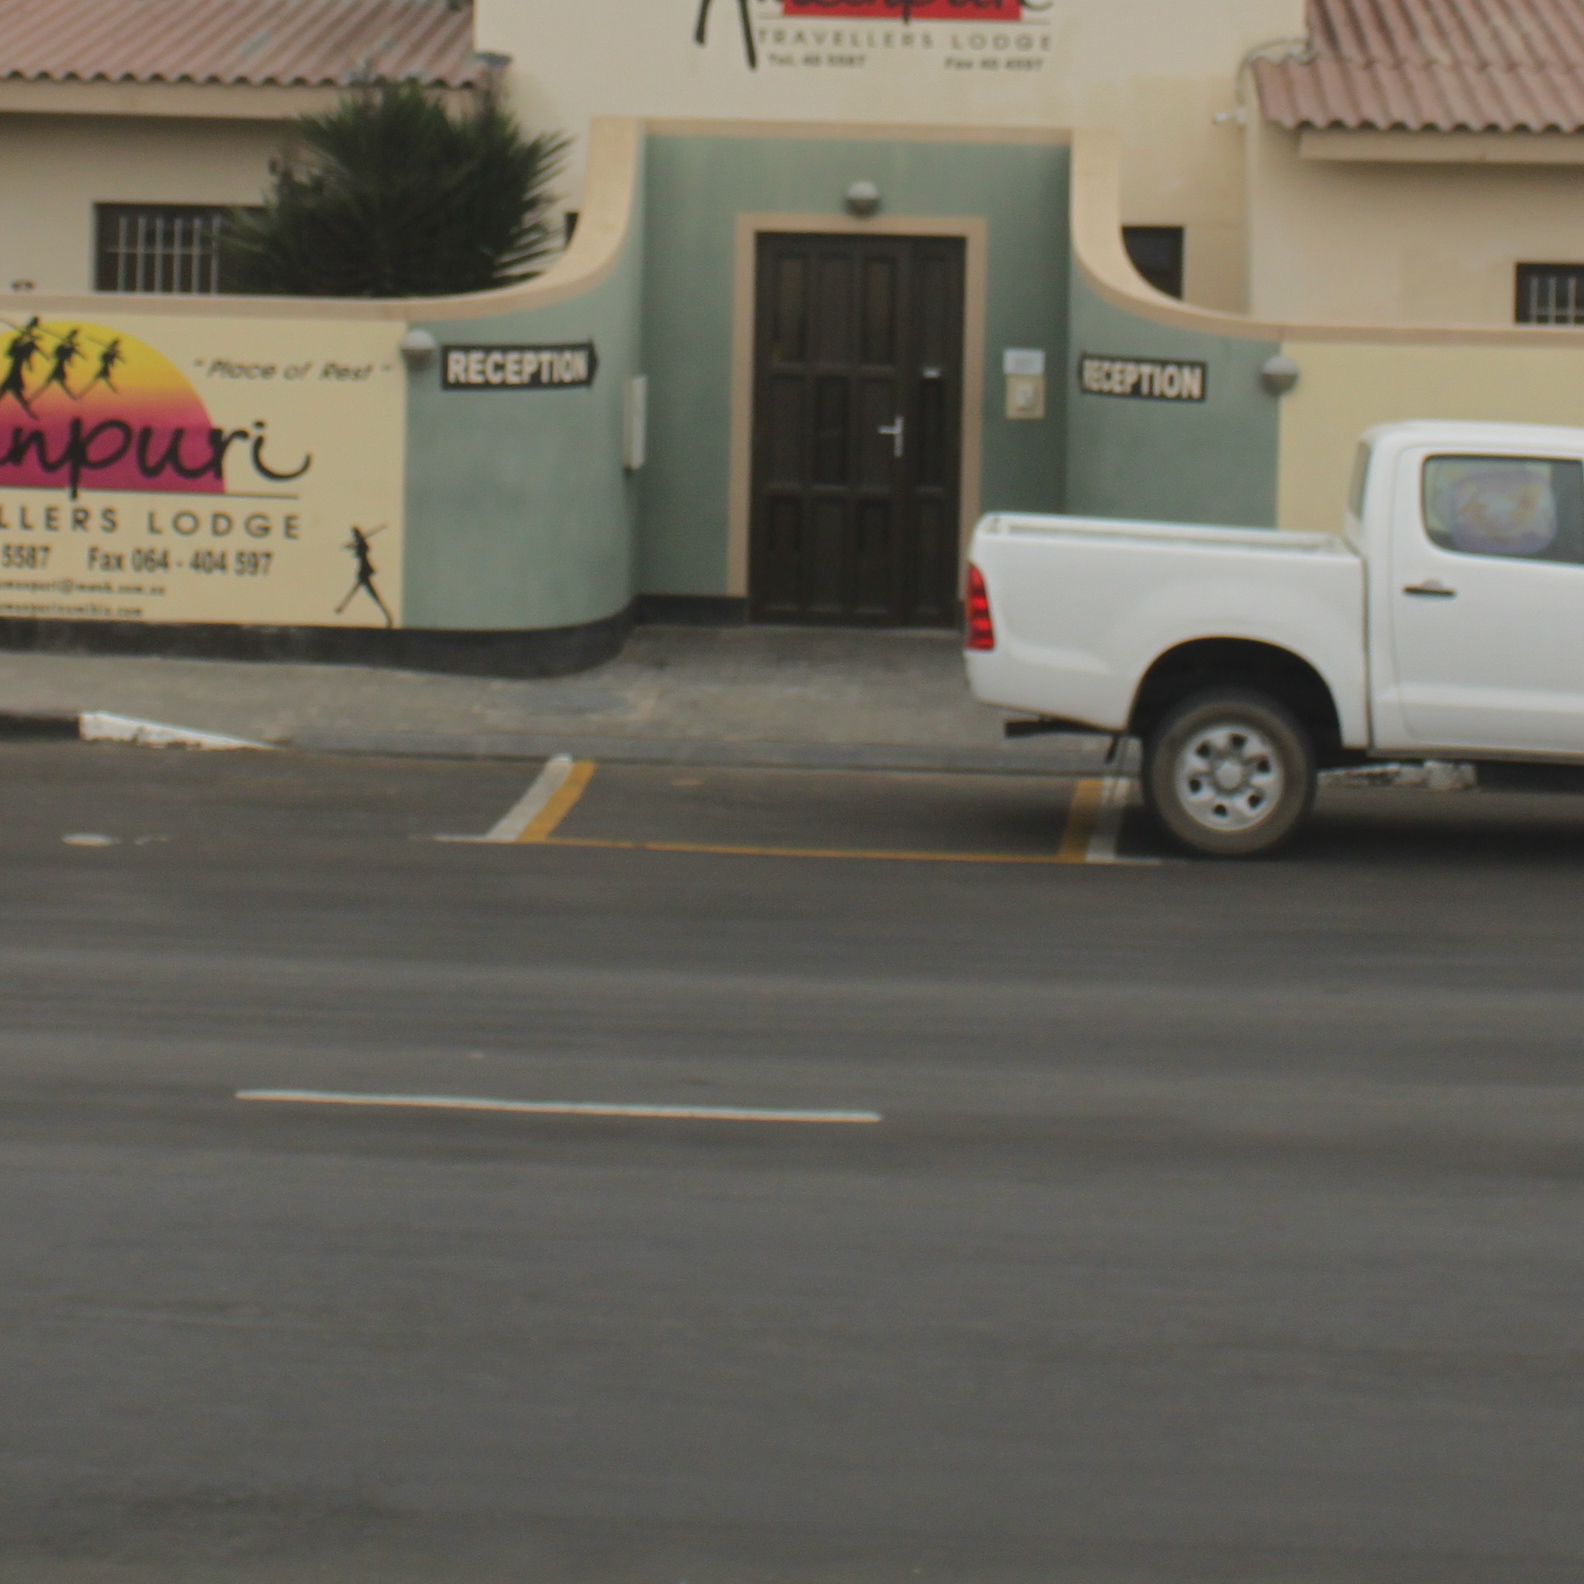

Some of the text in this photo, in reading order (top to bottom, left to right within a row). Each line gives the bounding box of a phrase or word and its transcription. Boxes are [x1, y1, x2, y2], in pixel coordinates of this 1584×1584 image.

[758, 28, 1052, 53] TRAVELLERS LODGE
[207, 358, 277, 381] Place
[283, 360, 314, 381] of
[319, 360, 374, 383] Rest
[446, 349, 589, 385] RECEPTION
[1082, 358, 1203, 400] RECEPTION
[147, 510, 300, 539] LODGE
[1, 545, 52, 570] 5587
[87, 546, 124, 572] Fax
[131, 548, 170, 573] 064
[189, 550, 228, 575] 404
[234, 551, 275, 577] 597
